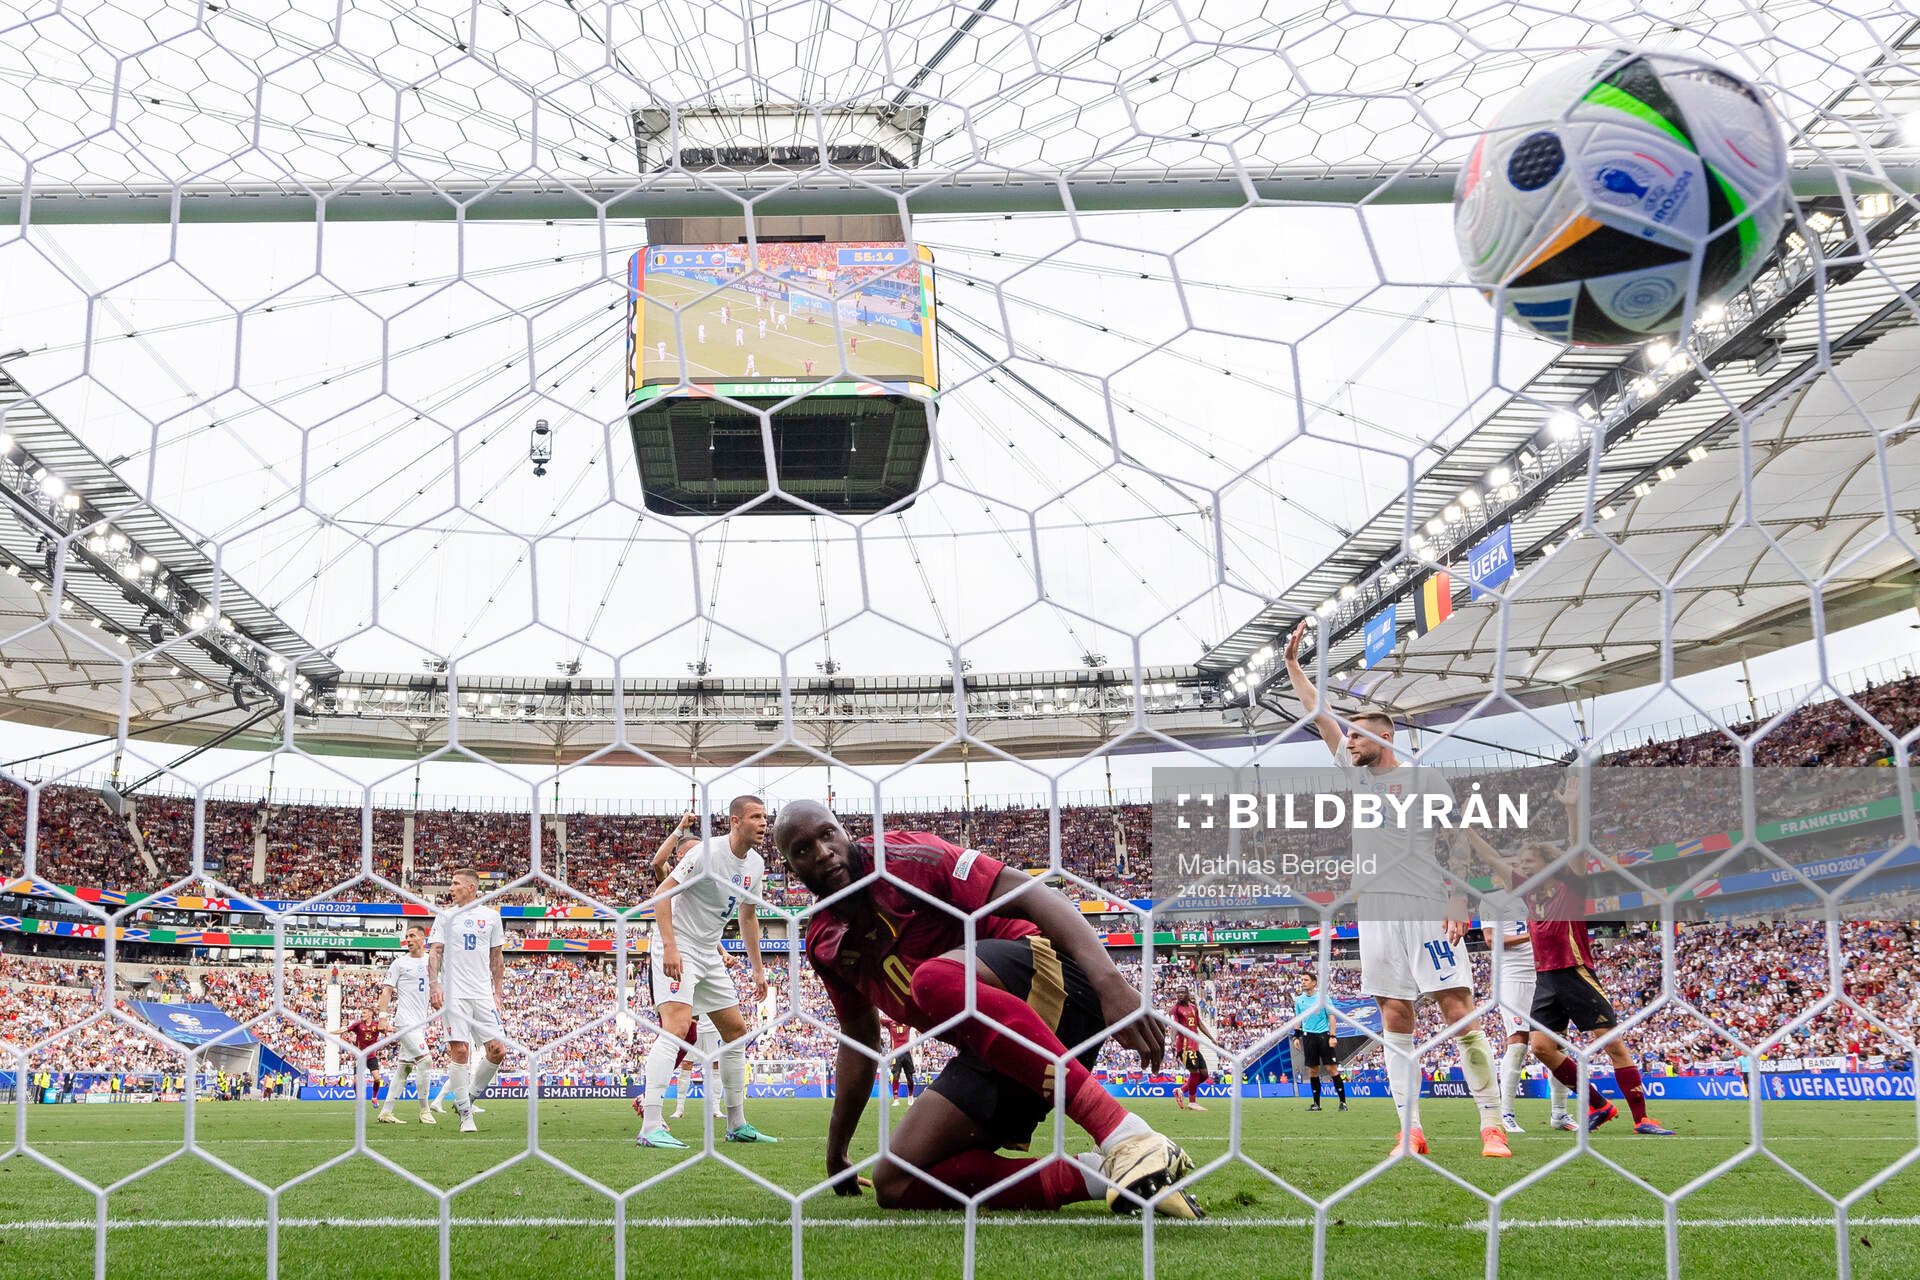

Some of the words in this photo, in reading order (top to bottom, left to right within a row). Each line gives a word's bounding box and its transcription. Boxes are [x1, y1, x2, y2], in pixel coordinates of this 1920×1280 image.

[673, 255, 684, 265] 0
[695, 255, 704, 264] 1
[854, 252, 895, 261] 55:14
[874, 315, 898, 327] vivo
[1471, 544, 1508, 581] UEFA
[1780, 807, 1868, 834] FRANKFURT
[285, 936, 354, 946] RANKFURT
[463, 934, 476, 950] 19
[1424, 940, 1455, 970] 14
[418, 978, 425, 991] 2
[485, 1088, 532, 1098] OFFICIA
[544, 1088, 627, 1098] SMARTPHONE
[1124, 1085, 1164, 1096] vivo
[1351, 1084, 1370, 1096] vivo
[1433, 1084, 1467, 1096] OFFICIAL
